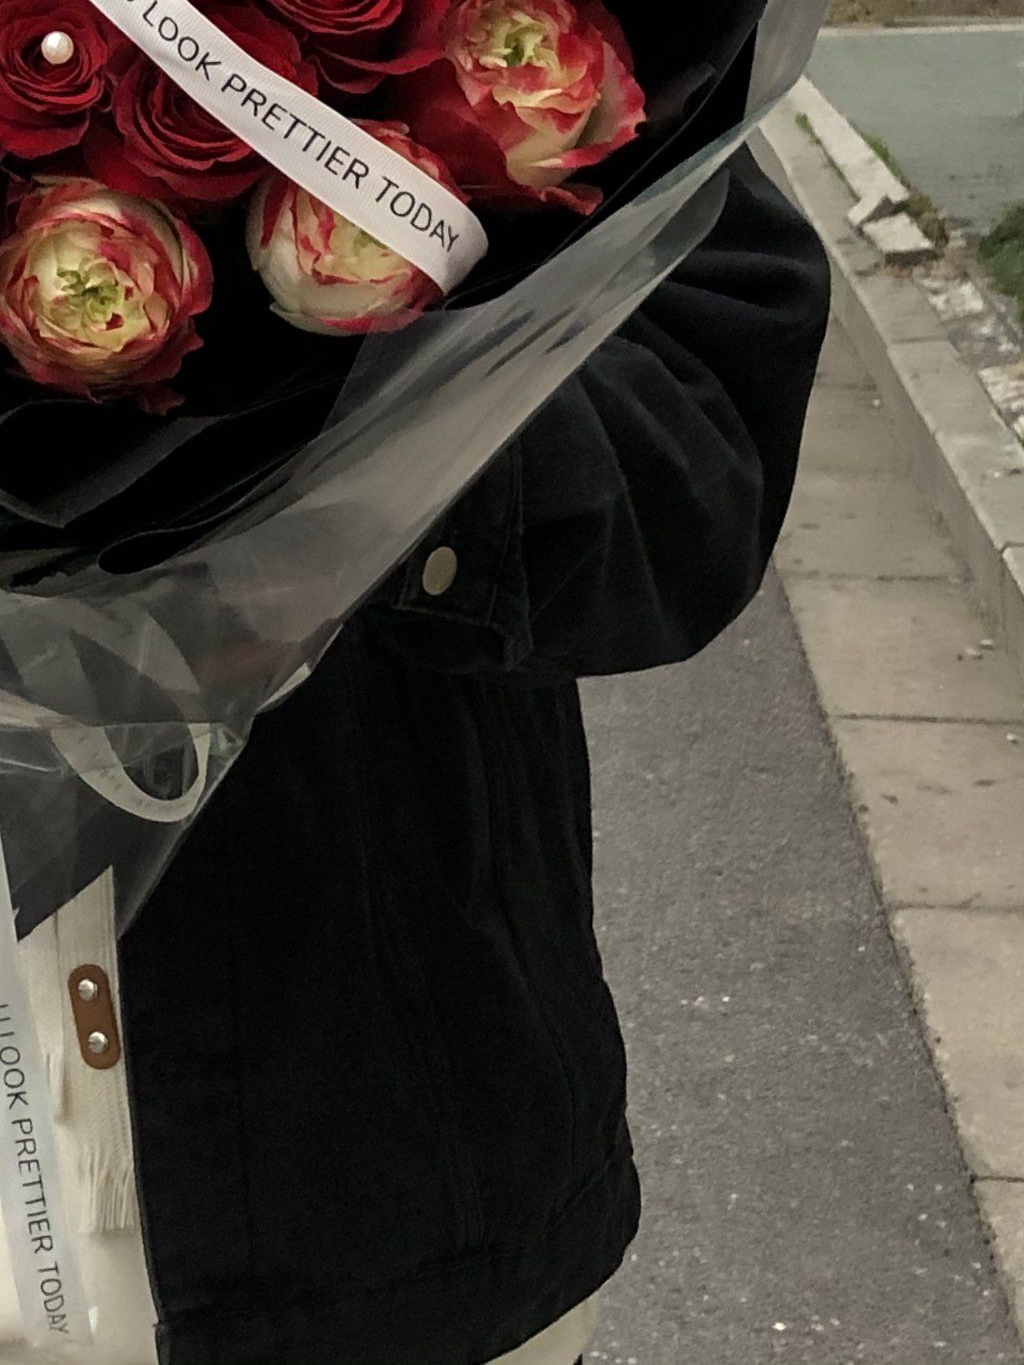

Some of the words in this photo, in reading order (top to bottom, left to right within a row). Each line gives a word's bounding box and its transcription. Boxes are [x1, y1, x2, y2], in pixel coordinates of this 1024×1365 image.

[142, 0, 223, 82] LOOK
[220, 73, 371, 190] PRETTIER
[375, 175, 460, 253] TODAY
[11, 1117, 54, 1255] PRETTIER
[37, 1263, 71, 1336] TODAY
